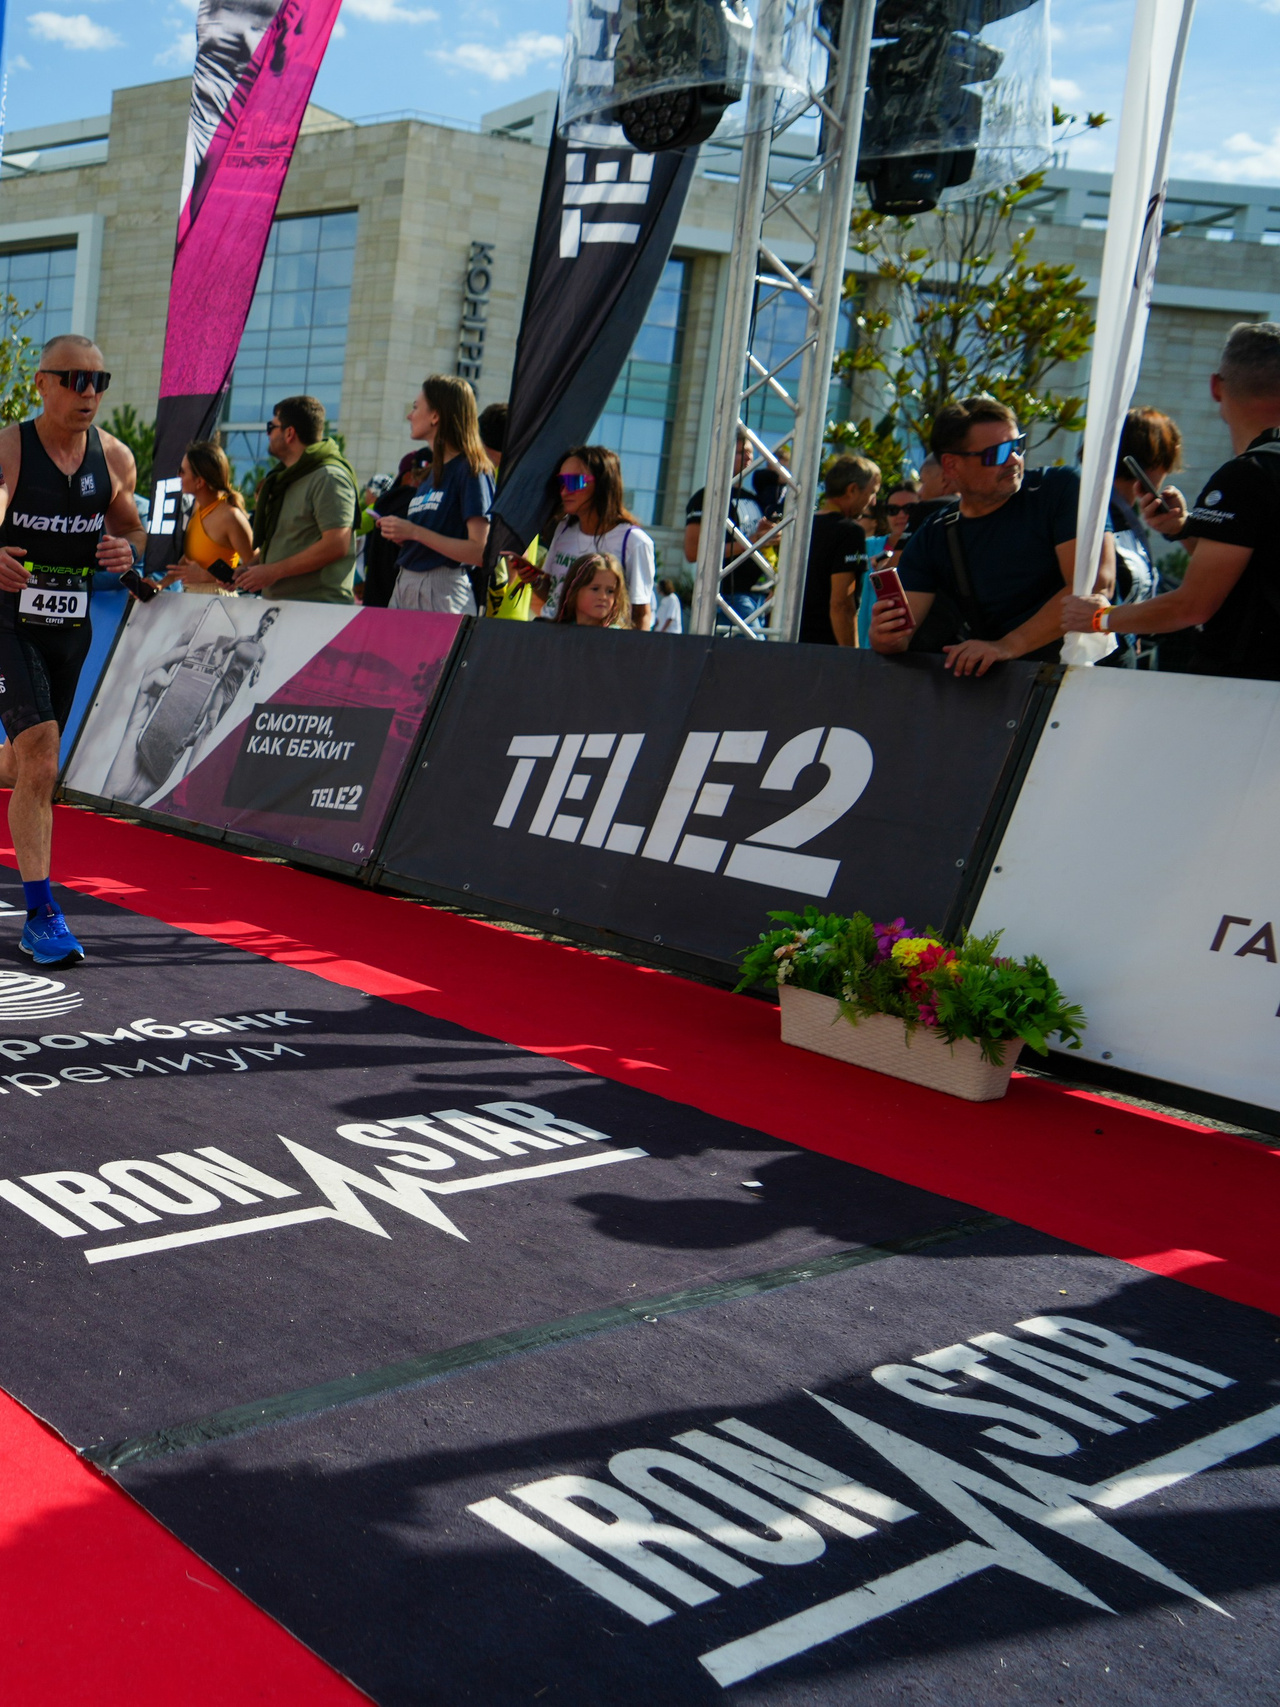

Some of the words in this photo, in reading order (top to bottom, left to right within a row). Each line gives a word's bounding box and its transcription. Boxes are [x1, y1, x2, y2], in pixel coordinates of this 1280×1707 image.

[32, 593, 78, 614] 4450
[45, 617, 65, 625] СЕРГЕЙ
[255, 712, 334, 738] СМОТРИ,
[246, 735, 285, 756] КАК
[286, 738, 355, 761] БЕЖИТ
[310, 785, 363, 811] TELE2
[492, 726, 874, 898] TELE2
[335, 1100, 612, 1172] STAR
[466, 1416, 919, 1627] IRON
[871, 1314, 1238, 1457] STAR
